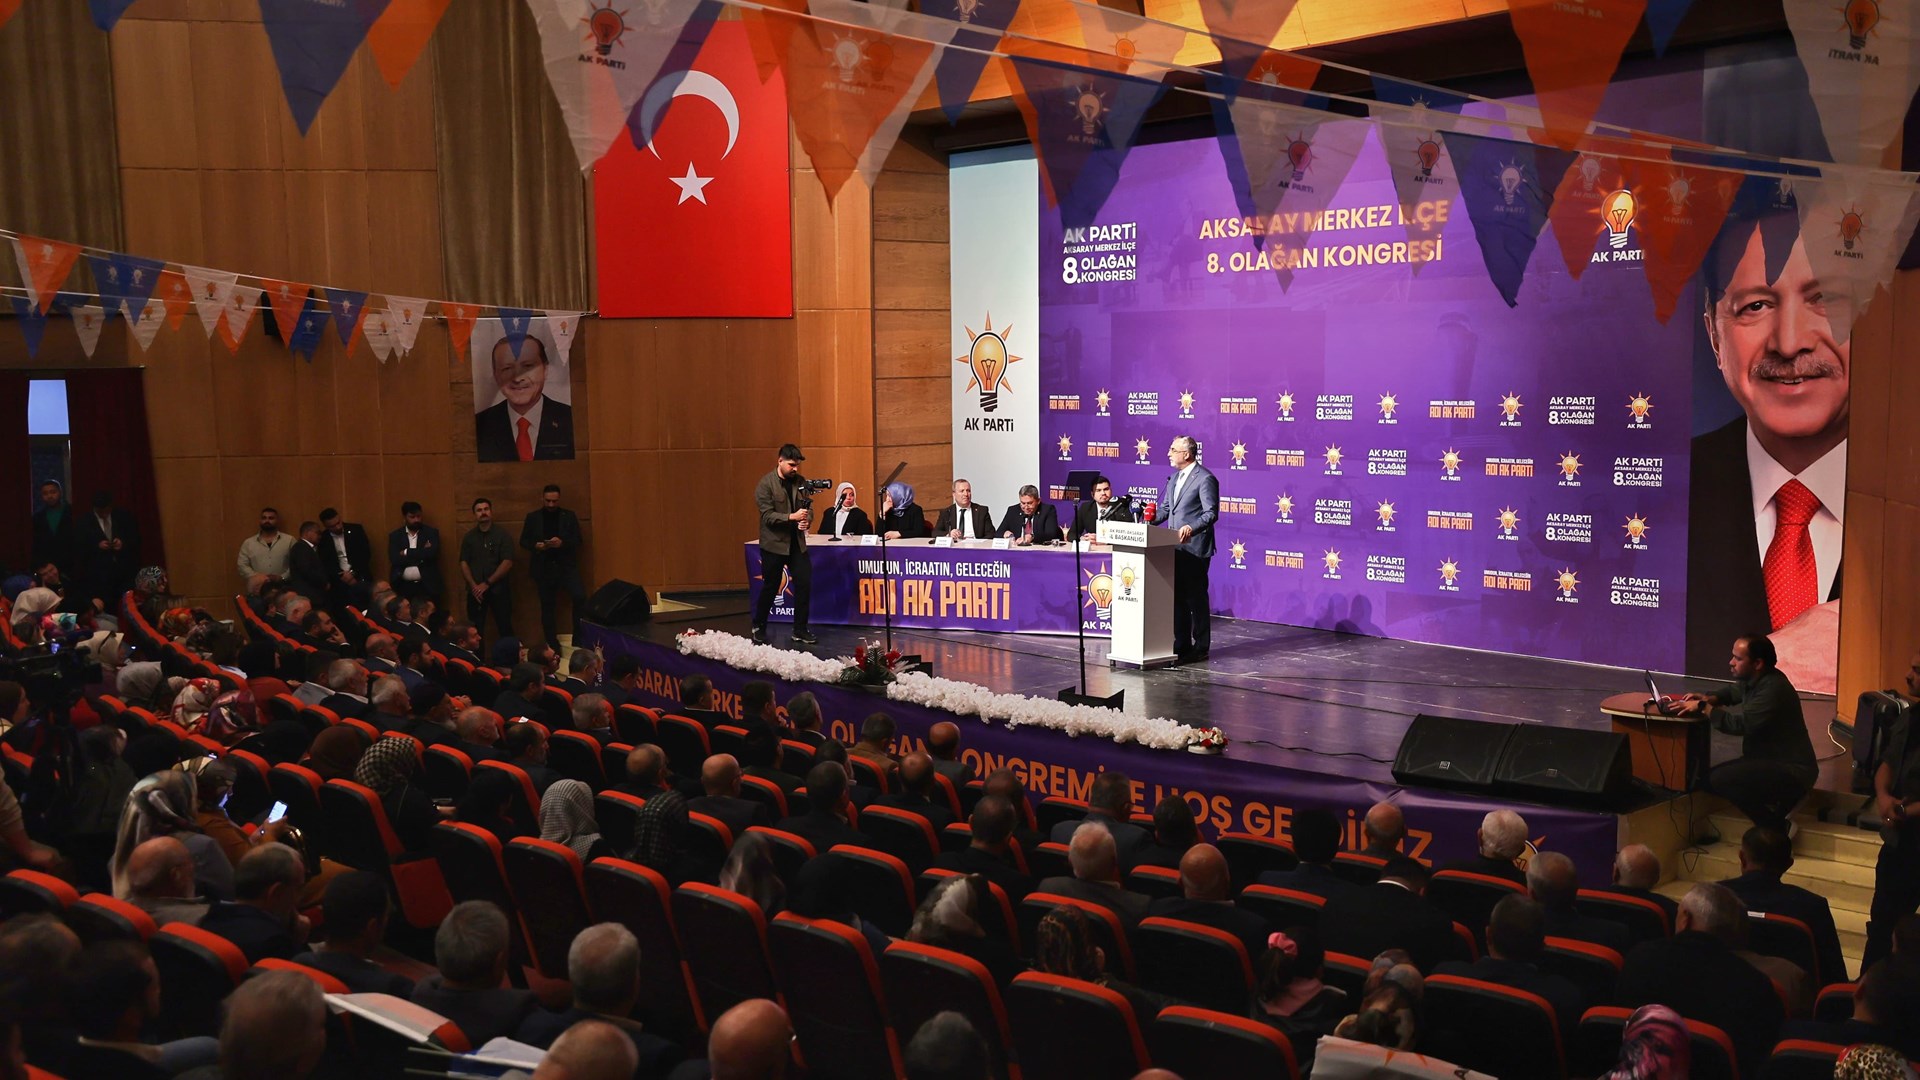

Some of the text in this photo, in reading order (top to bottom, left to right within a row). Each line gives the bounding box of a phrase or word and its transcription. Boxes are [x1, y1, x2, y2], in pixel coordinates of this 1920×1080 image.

[579, 55, 593, 63] AK
[1278, 181, 1289, 189] AK
[1304, 205, 1392, 232] MERKEZ
[1063, 228, 1086, 244] AK
[1063, 245, 1094, 254] AKSARAY
[1095, 243, 1120, 252] MERKEZ
[1207, 233, 1442, 273] 8. OLAĞAN KONGRESİ
[1591, 251, 1609, 262] AK
[1081, 254, 1136, 270] OLAĞAN
[1550, 397, 1564, 405] AK
[964, 418, 979, 430] AK
[1369, 449, 1380, 457] AK
[1614, 457, 1629, 466] AK
[1315, 499, 1327, 507] AK
[1547, 513, 1560, 521] AK
[1367, 555, 1378, 563] AK
[956, 561, 1011, 578] GELECEĞİN
[1612, 576, 1626, 585] AK
[903, 579, 933, 616] AK
[1083, 621, 1096, 629] AK
[636, 668, 682, 702] SARAY
